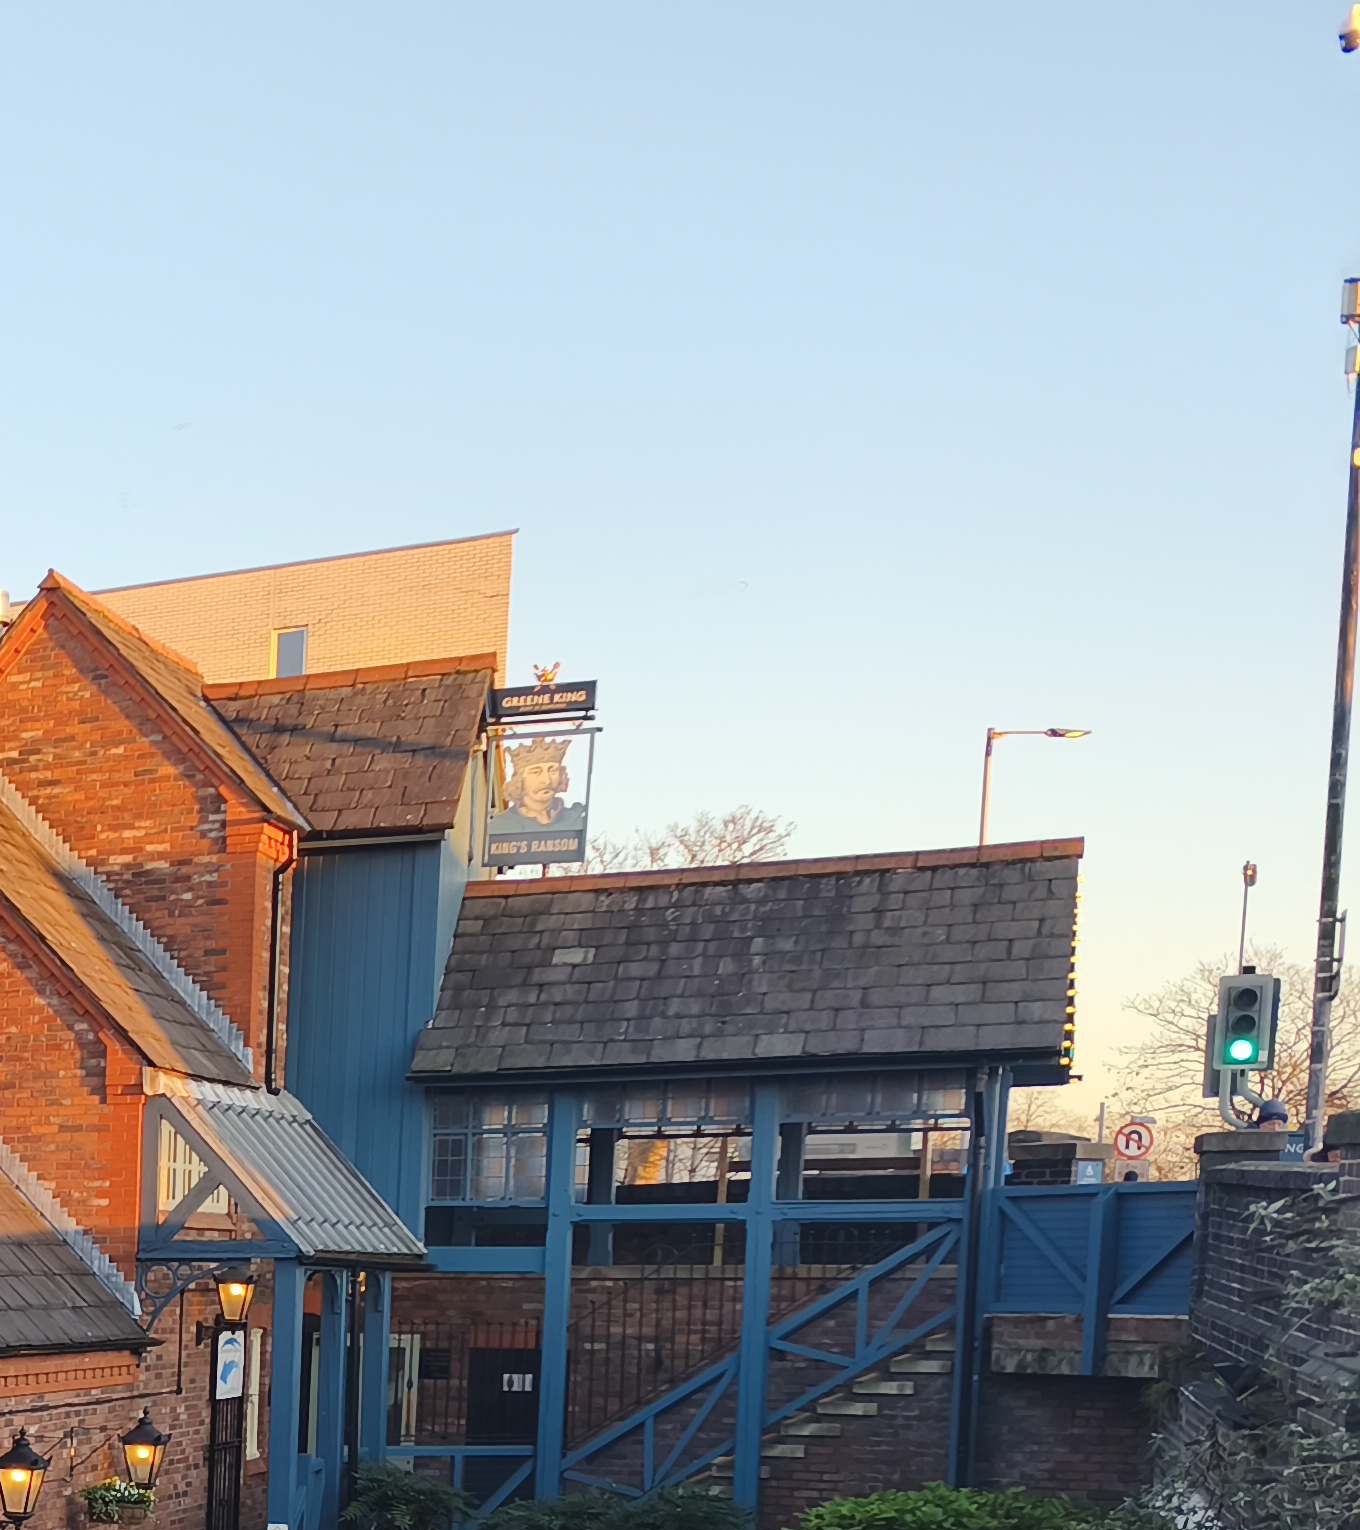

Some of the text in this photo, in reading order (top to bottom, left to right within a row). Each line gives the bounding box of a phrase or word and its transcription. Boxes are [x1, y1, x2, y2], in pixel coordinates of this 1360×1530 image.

[502, 691, 586, 707] GREENE KING
[490, 837, 578, 855] KING'S RANSOM
